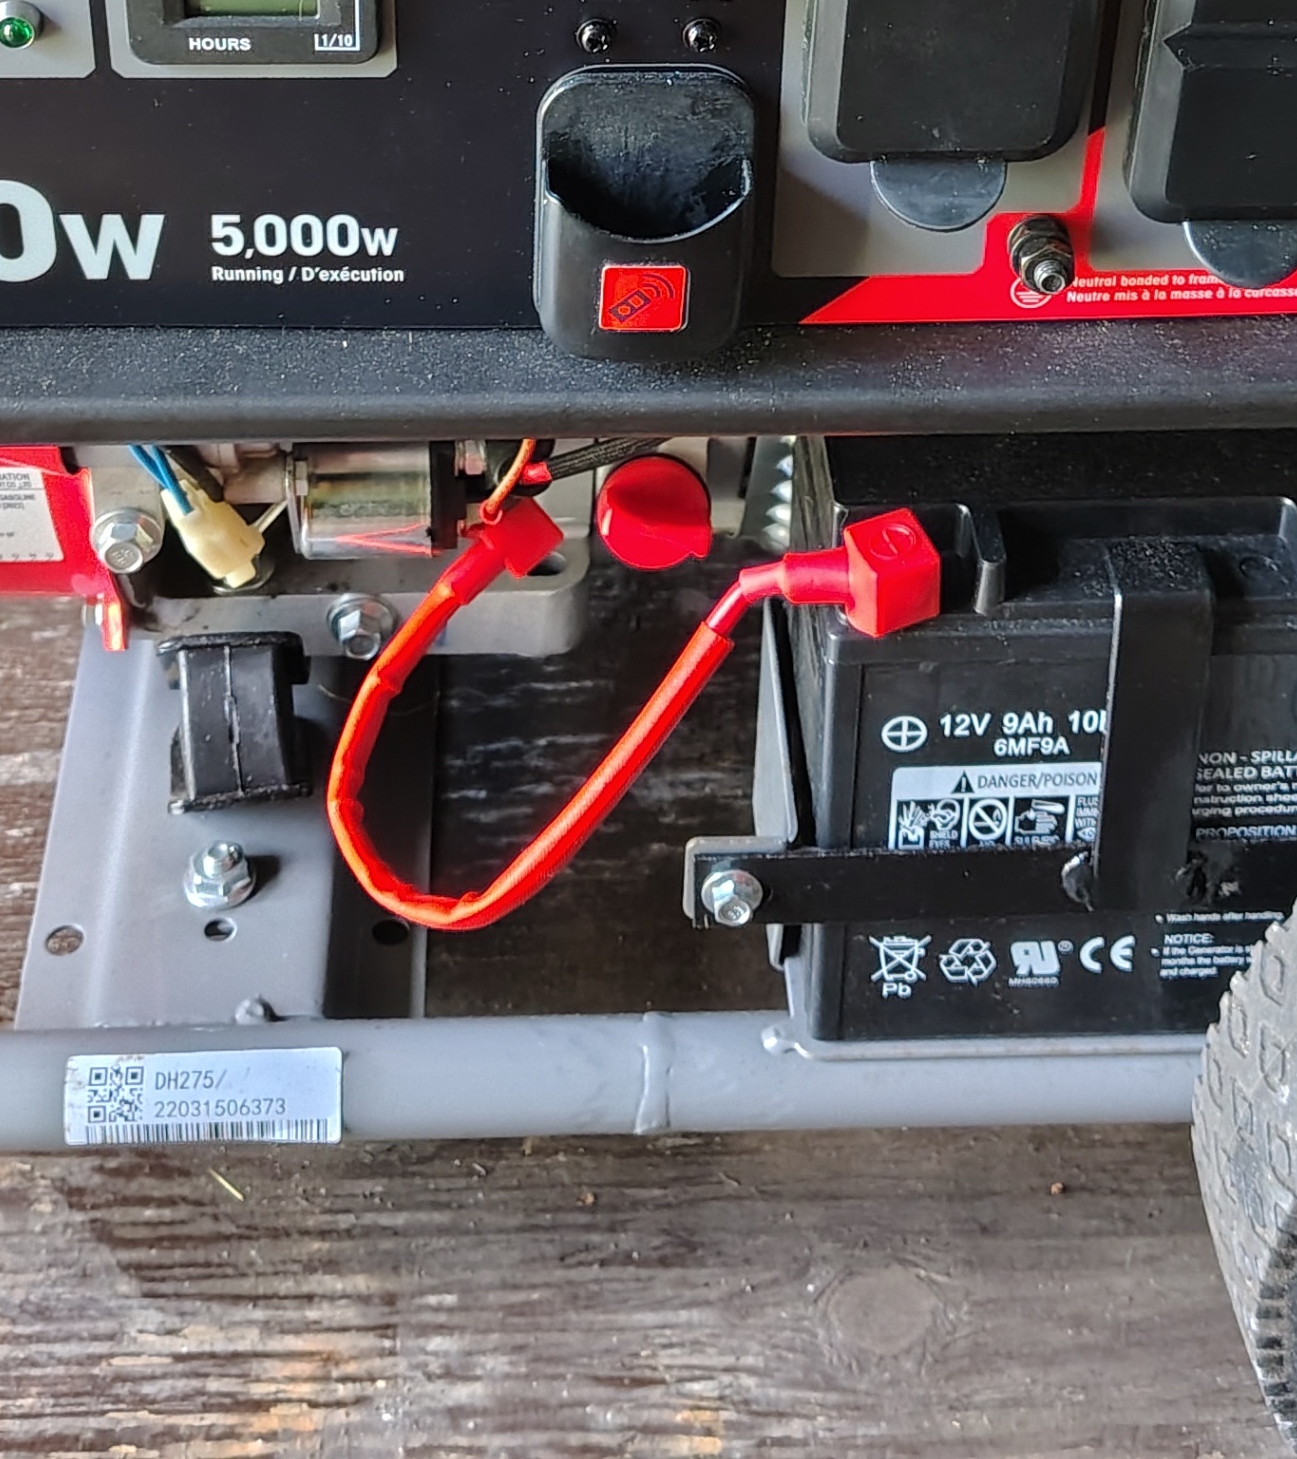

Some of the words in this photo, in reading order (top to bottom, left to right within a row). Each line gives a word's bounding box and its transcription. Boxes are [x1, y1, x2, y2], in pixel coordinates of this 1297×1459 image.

[189, 37, 252, 52] HOURS
[321, 33, 353, 48] 1/10
[211, 265, 285, 287] Running
[1120, 275, 1169, 288] bonded
[1172, 274, 1186, 286] to
[1188, 273, 1225, 286] fram
[1066, 291, 1111, 303] Neutre
[1114, 291, 1139, 302] mis
[1153, 290, 1167, 301] la
[1170, 290, 1214, 301] masse
[1228, 288, 1242, 299] la
[939, 711, 992, 738] 12V
[1002, 710, 1054, 735] 9Ah
[993, 736, 1071, 757] 6MF9A
[977, 770, 1098, 791] DANGER/POISON
[1233, 781, 1290, 792] owner's
[1193, 793, 1264, 805] nstruction
[1195, 824, 1297, 838] PROPOSITION
[1193, 912, 1221, 922] hands
[1164, 932, 1215, 944] NOTICE:
[1079, 935, 1136, 973] CE
[882, 981, 912, 999] Pb
[153, 1098, 287, 1119] 22031506373
